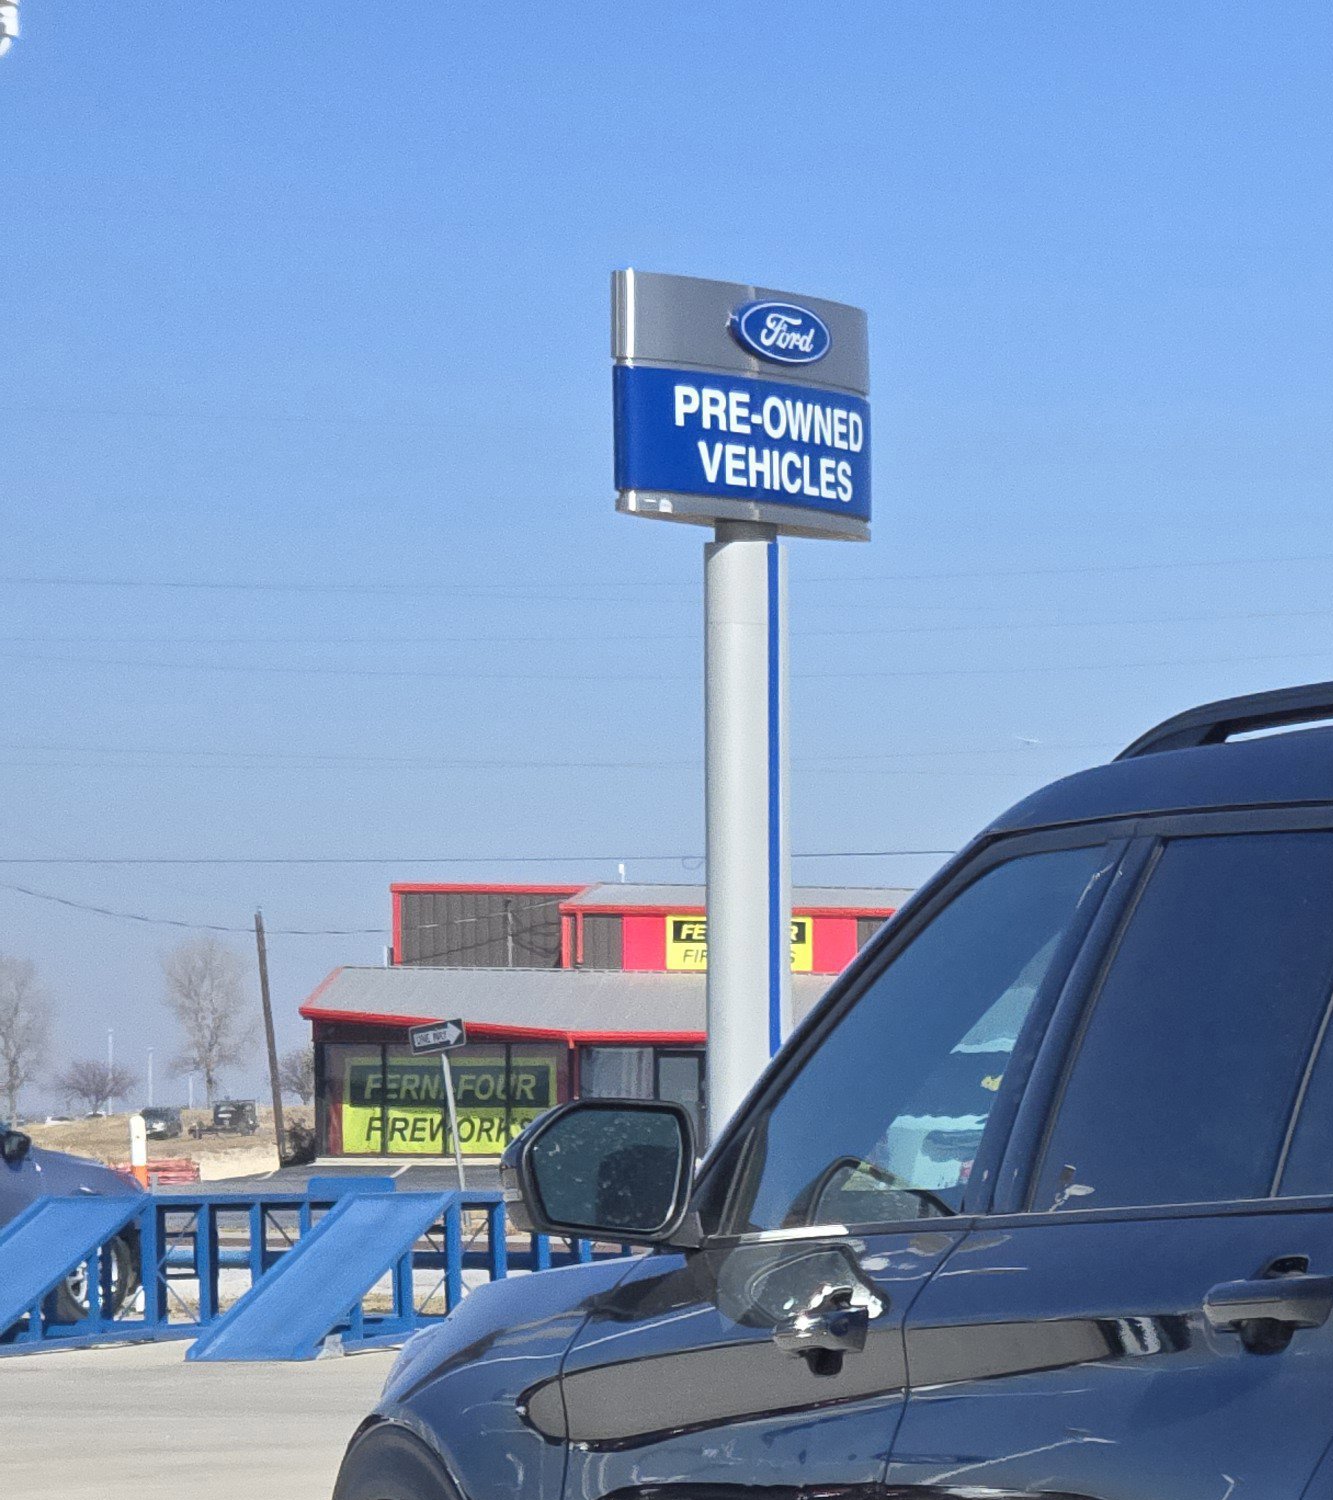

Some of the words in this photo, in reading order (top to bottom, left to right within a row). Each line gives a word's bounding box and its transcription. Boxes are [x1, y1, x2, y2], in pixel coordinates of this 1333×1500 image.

[760, 312, 815, 353] Ford
[674, 385, 863, 452] PRE-OWNED
[698, 440, 852, 502] VEHICLES
